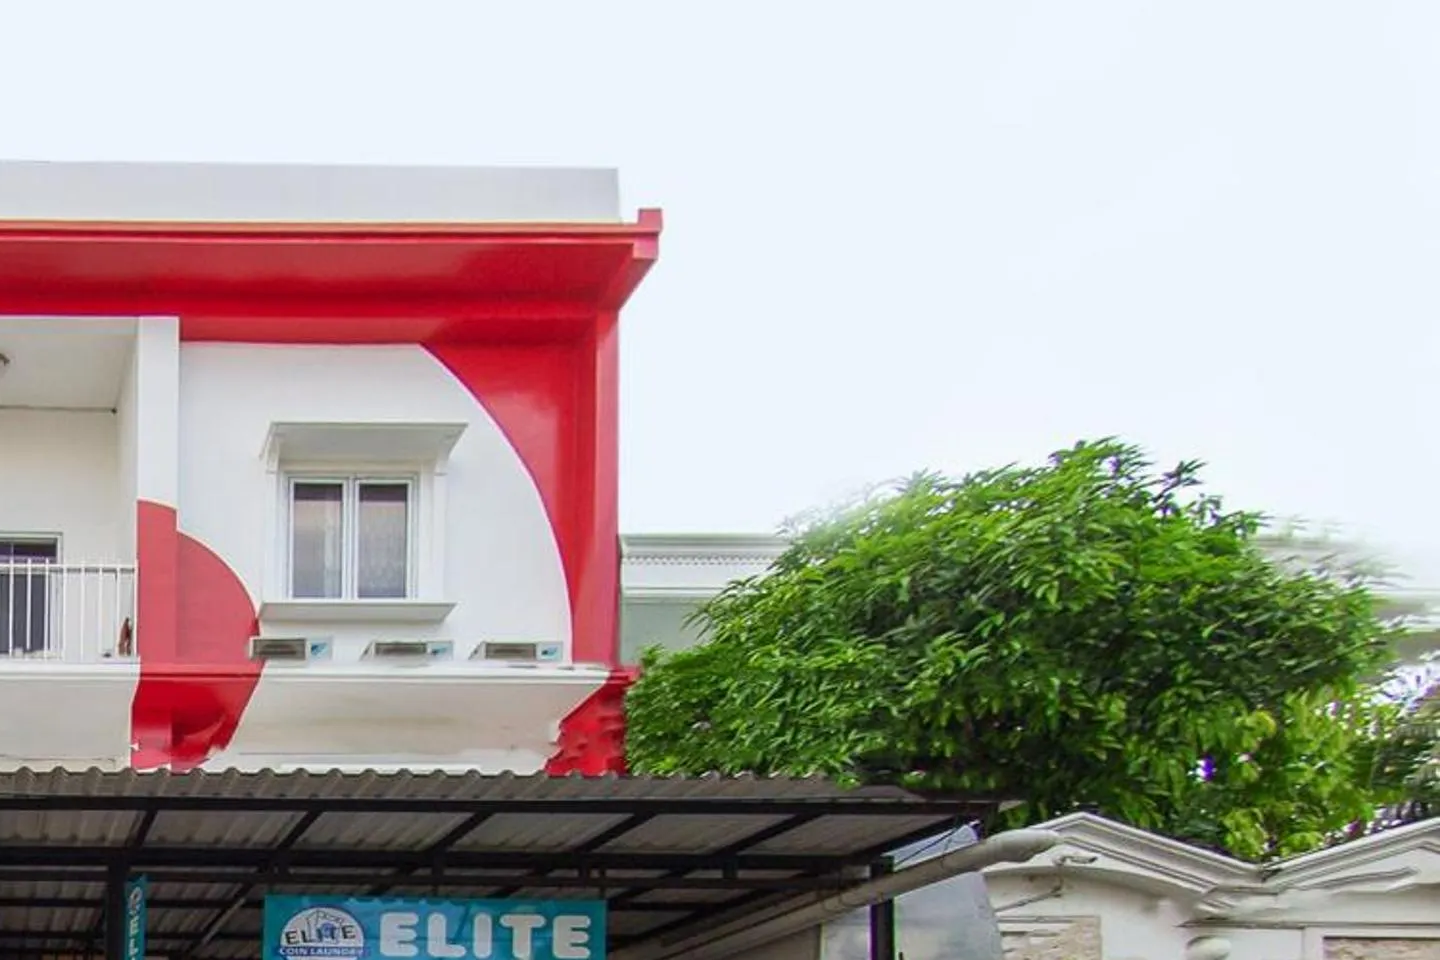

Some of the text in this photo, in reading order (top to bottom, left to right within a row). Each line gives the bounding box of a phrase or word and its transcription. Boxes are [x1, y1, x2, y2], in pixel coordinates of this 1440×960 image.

[285, 925, 356, 945] ELITE
[379, 912, 591, 960] ELITE
[279, 946, 308, 956] COIN
